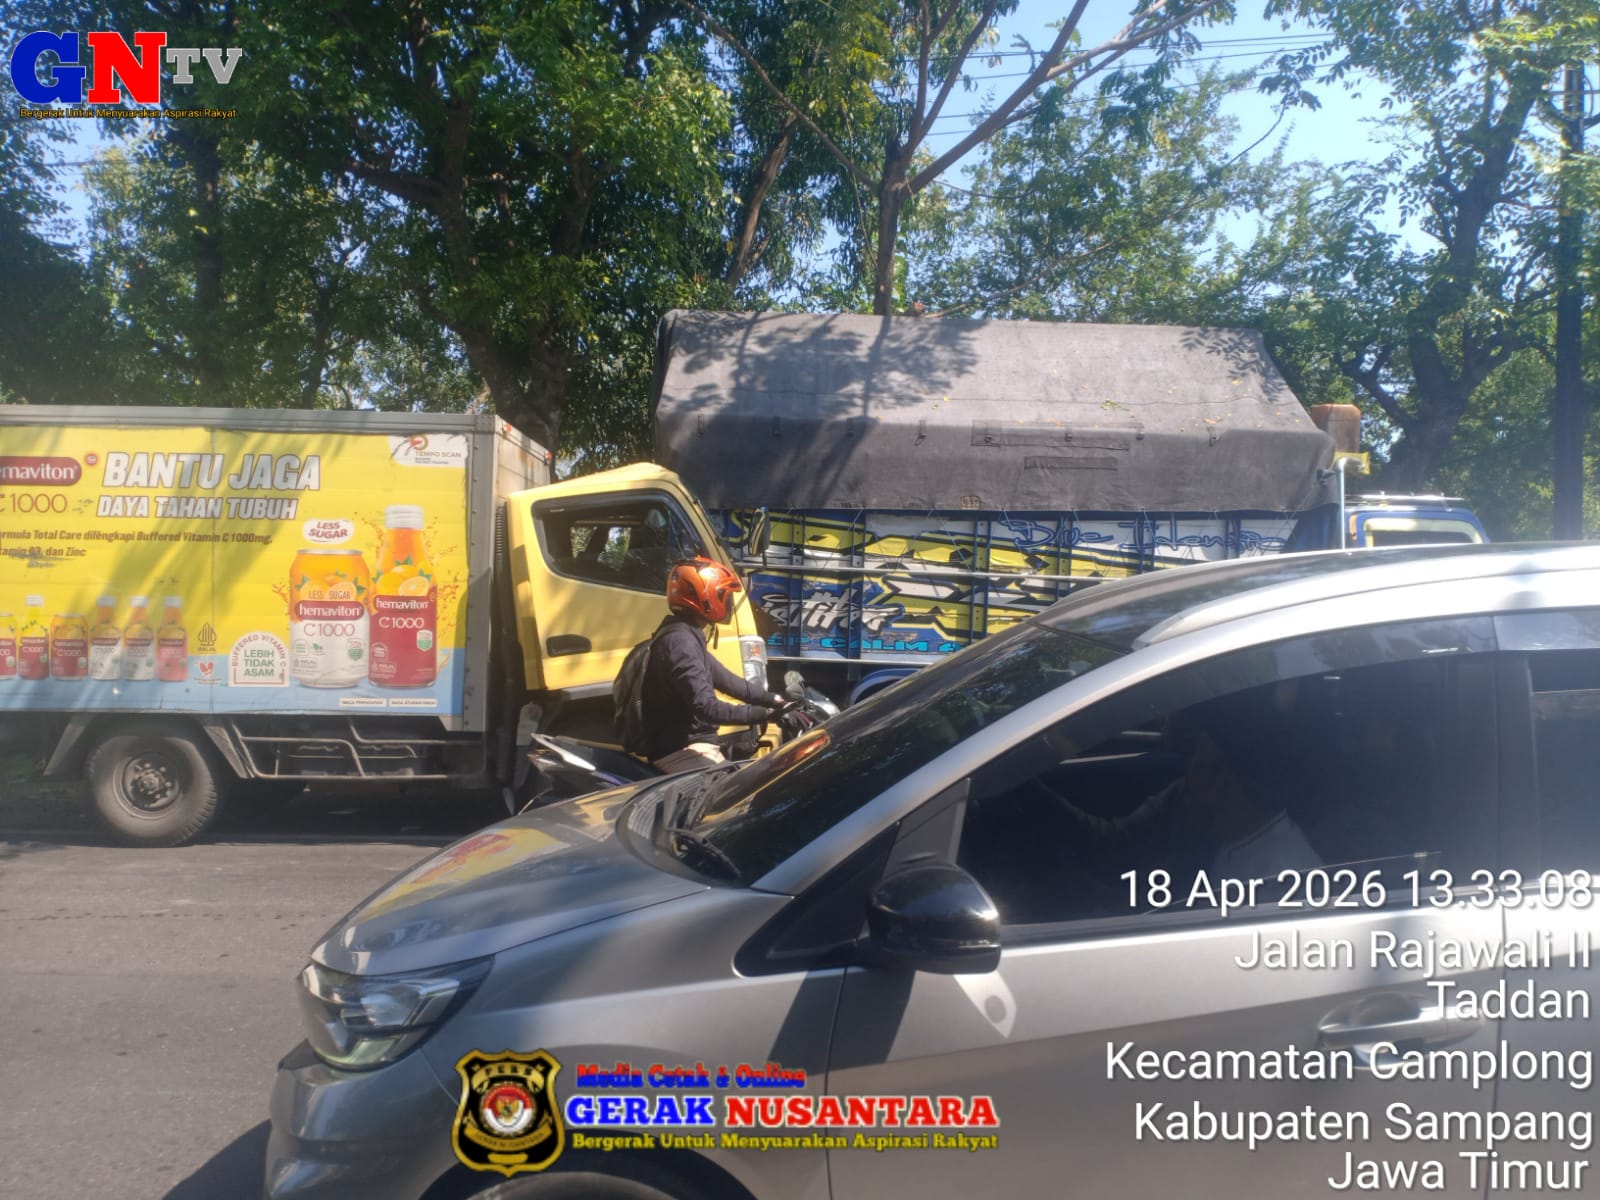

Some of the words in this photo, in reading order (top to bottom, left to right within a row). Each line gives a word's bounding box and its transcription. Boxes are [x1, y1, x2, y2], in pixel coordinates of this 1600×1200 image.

[0, 463, 76, 480] maviton
[102, 452, 224, 488] BANTU
[229, 453, 320, 491] JAGA
[96, 495, 150, 518] DAYA
[154, 497, 222, 519] TAHAN
[227, 498, 298, 520] TUBUH
[316, 521, 341, 530] LESS
[0, 529, 31, 540] rmula
[33, 529, 58, 540] Total
[60, 530, 82, 540] Care
[83, 530, 135, 543] dilengkapi
[137, 531, 181, 542] Buffered
[184, 532, 220, 543] Vitamin
[307, 528, 349, 539] SUGAR
[45, 547, 64, 556] dan
[66, 547, 87, 557] Zinc
[308, 590, 323, 600] LESS
[328, 590, 351, 600] SUGAR
[375, 598, 428, 611] hemaviton
[299, 604, 361, 617] hemaviton
[244, 650, 275, 658] LEBIH
[244, 659, 275, 667] TIDAK
[244, 669, 275, 677] ASAM
